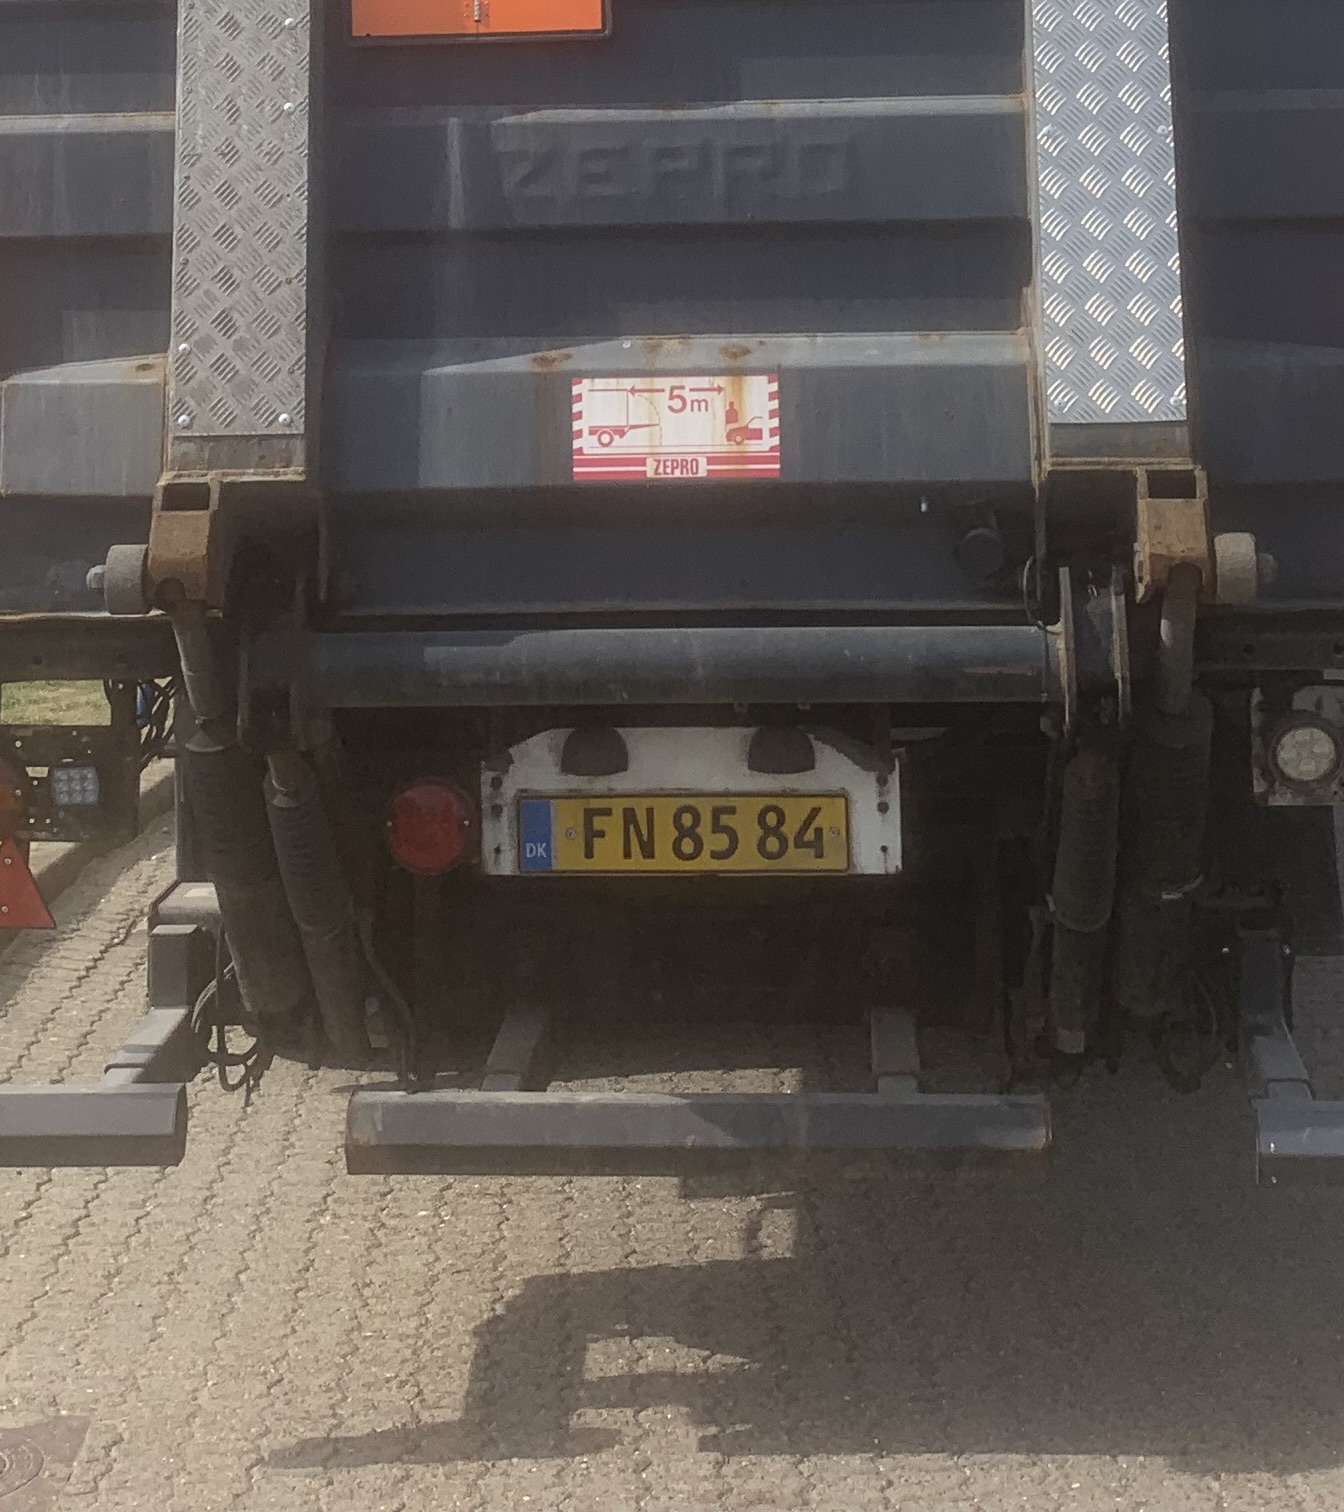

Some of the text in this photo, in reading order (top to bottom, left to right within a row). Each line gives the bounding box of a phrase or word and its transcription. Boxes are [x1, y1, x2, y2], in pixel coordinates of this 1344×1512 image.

[496, 135, 849, 199] ZEPRO
[653, 458, 699, 476] ZEPRO
[526, 843, 548, 859] DK
